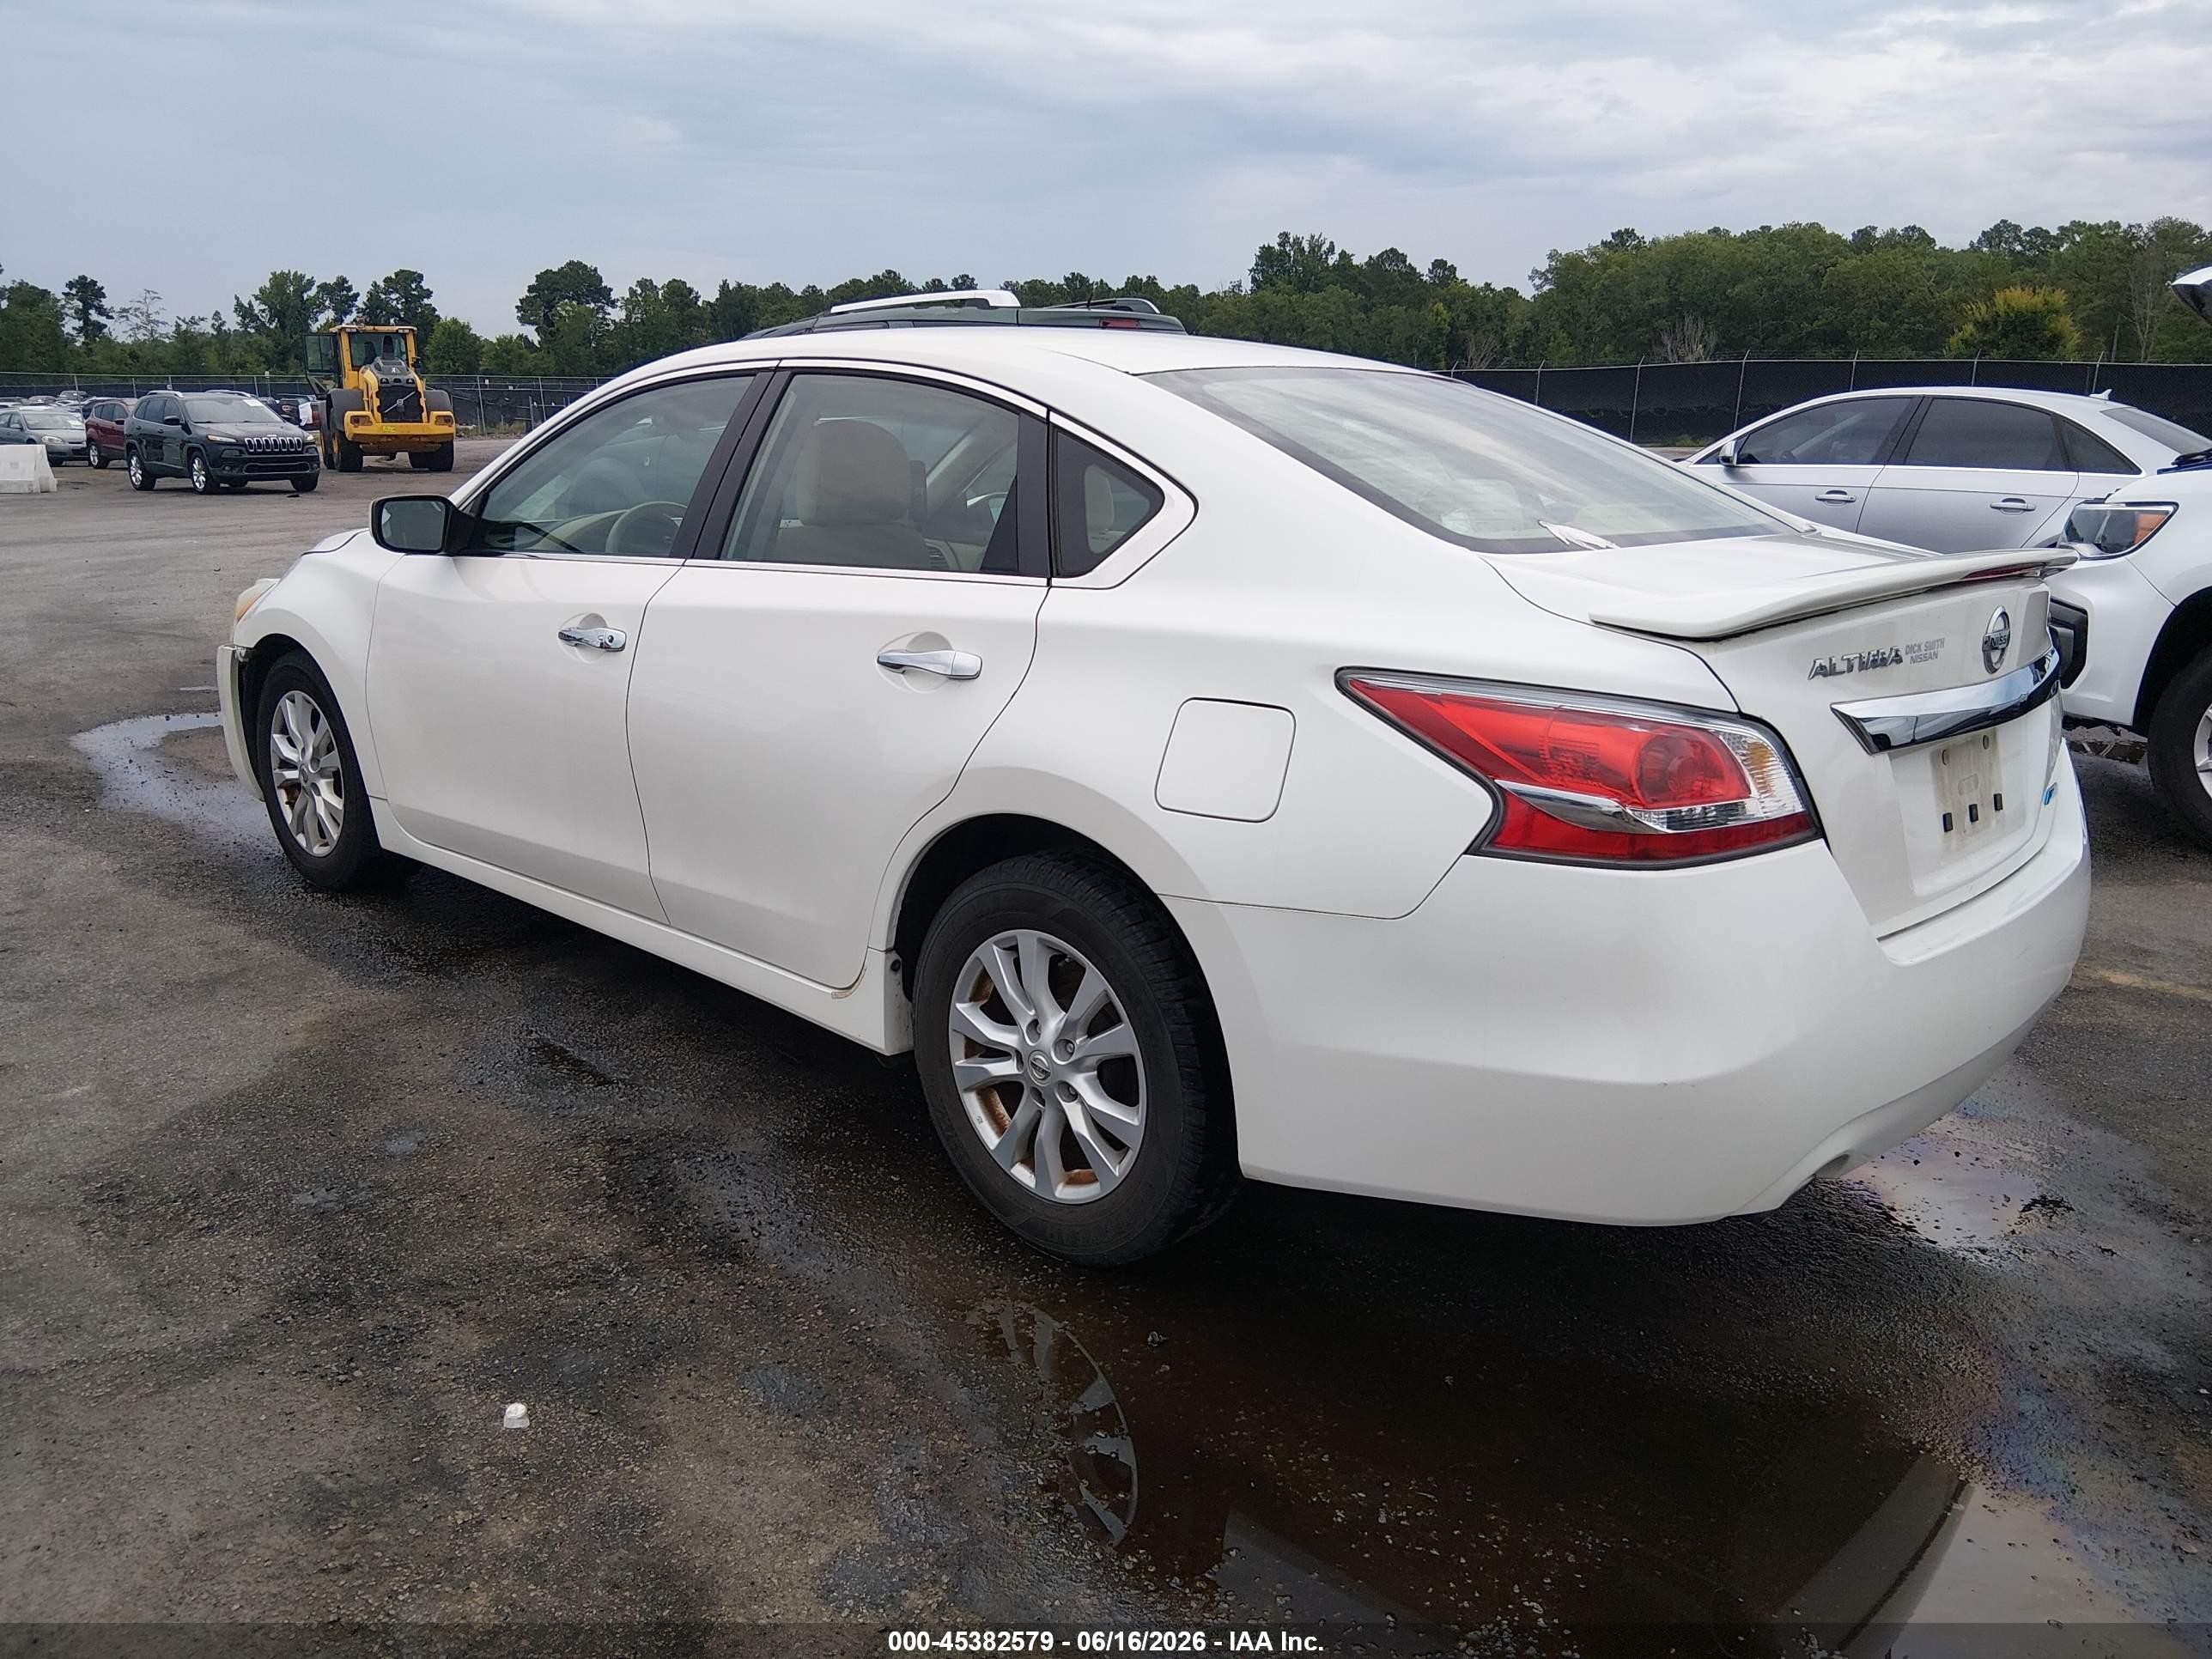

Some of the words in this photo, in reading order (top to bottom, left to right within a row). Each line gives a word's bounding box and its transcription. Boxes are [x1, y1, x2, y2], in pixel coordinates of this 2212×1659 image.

[1905, 642, 1922, 655] DICK
[1924, 637, 1945, 653] SMITH
[1910, 650, 1939, 665] NISSAN
